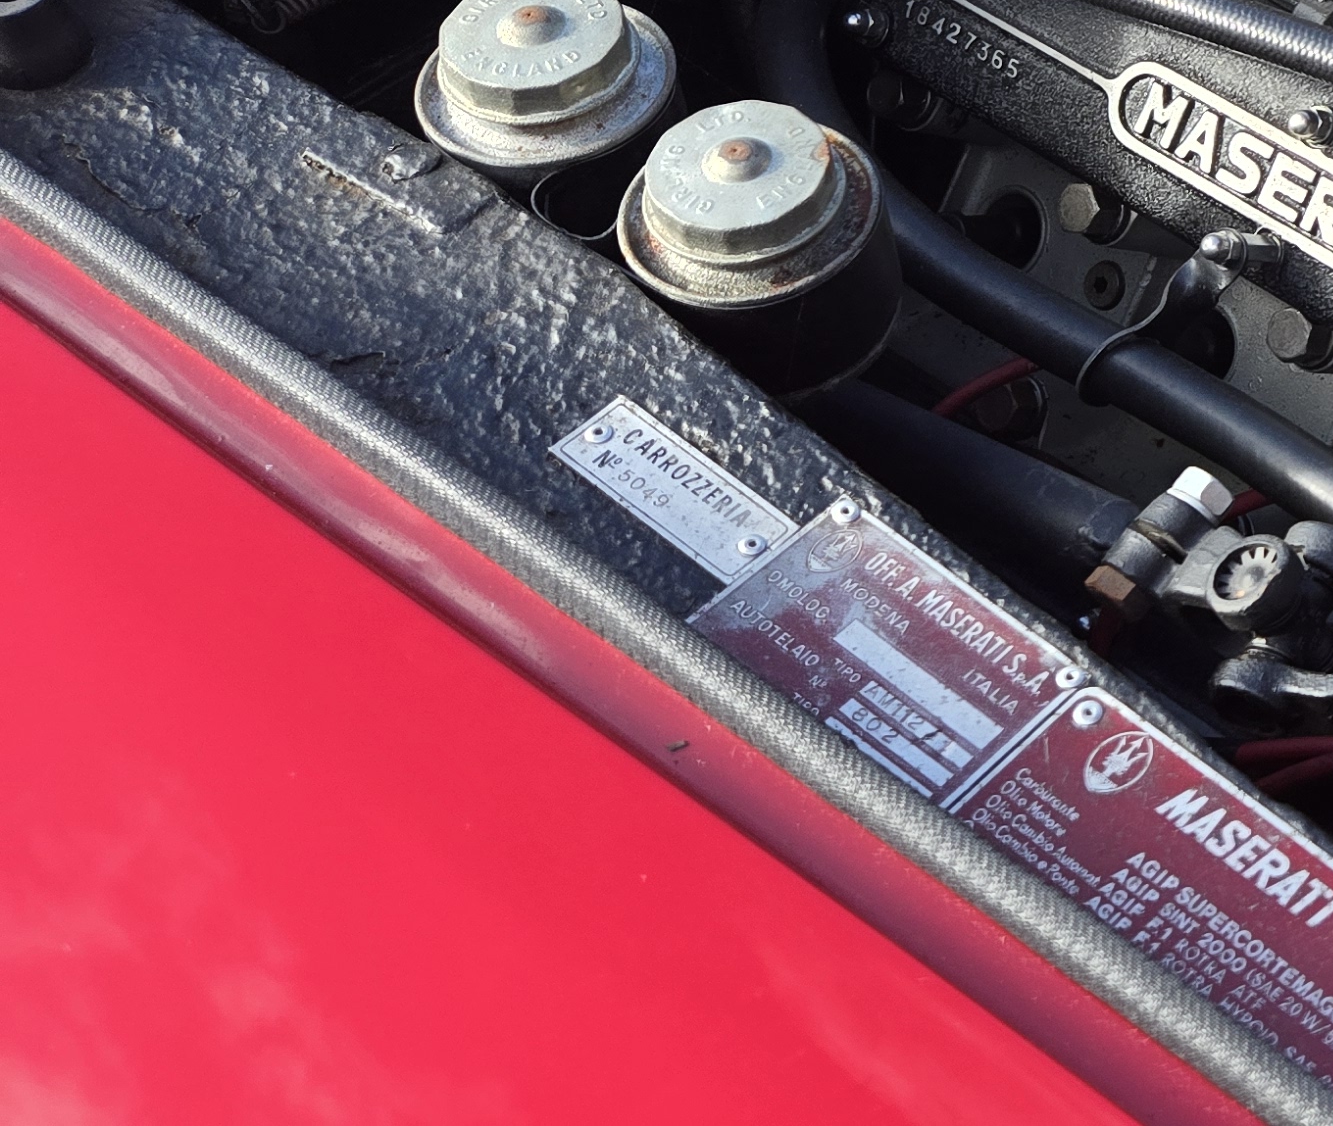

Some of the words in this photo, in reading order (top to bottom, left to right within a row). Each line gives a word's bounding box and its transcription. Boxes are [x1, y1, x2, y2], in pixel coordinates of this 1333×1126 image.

[461, 45, 581, 78] ENGLAND
[904, 0, 1020, 79] 18427365
[617, 467, 670, 507] 5049
[621, 428, 752, 525] CARROZZERIA
[729, 599, 820, 666] AUTOTELAIO
[831, 660, 862, 683] TIPO
[839, 579, 911, 632] MODENA
[963, 669, 1020, 712] ITALIA
[864, 553, 903, 582] OFF.
[896, 576, 921, 596] A.
[913, 589, 1013, 663] MASERATI
[851, 708, 899, 744] 802
[971, 808, 997, 832] Olio
[995, 826, 1039, 863] Cambio
[986, 795, 1013, 821] Olio
[1010, 815, 1054, 852] Cambio
[1015, 768, 1081, 822] Carburante
[1127, 852, 1180, 891] AGIP
[1000, 781, 1028, 807] Olio
[1026, 802, 1067, 838] Motore
[1112, 868, 1159, 903] AGIP
[1159, 905, 1198, 934] SINT
[1197, 934, 1247, 971] 2000
